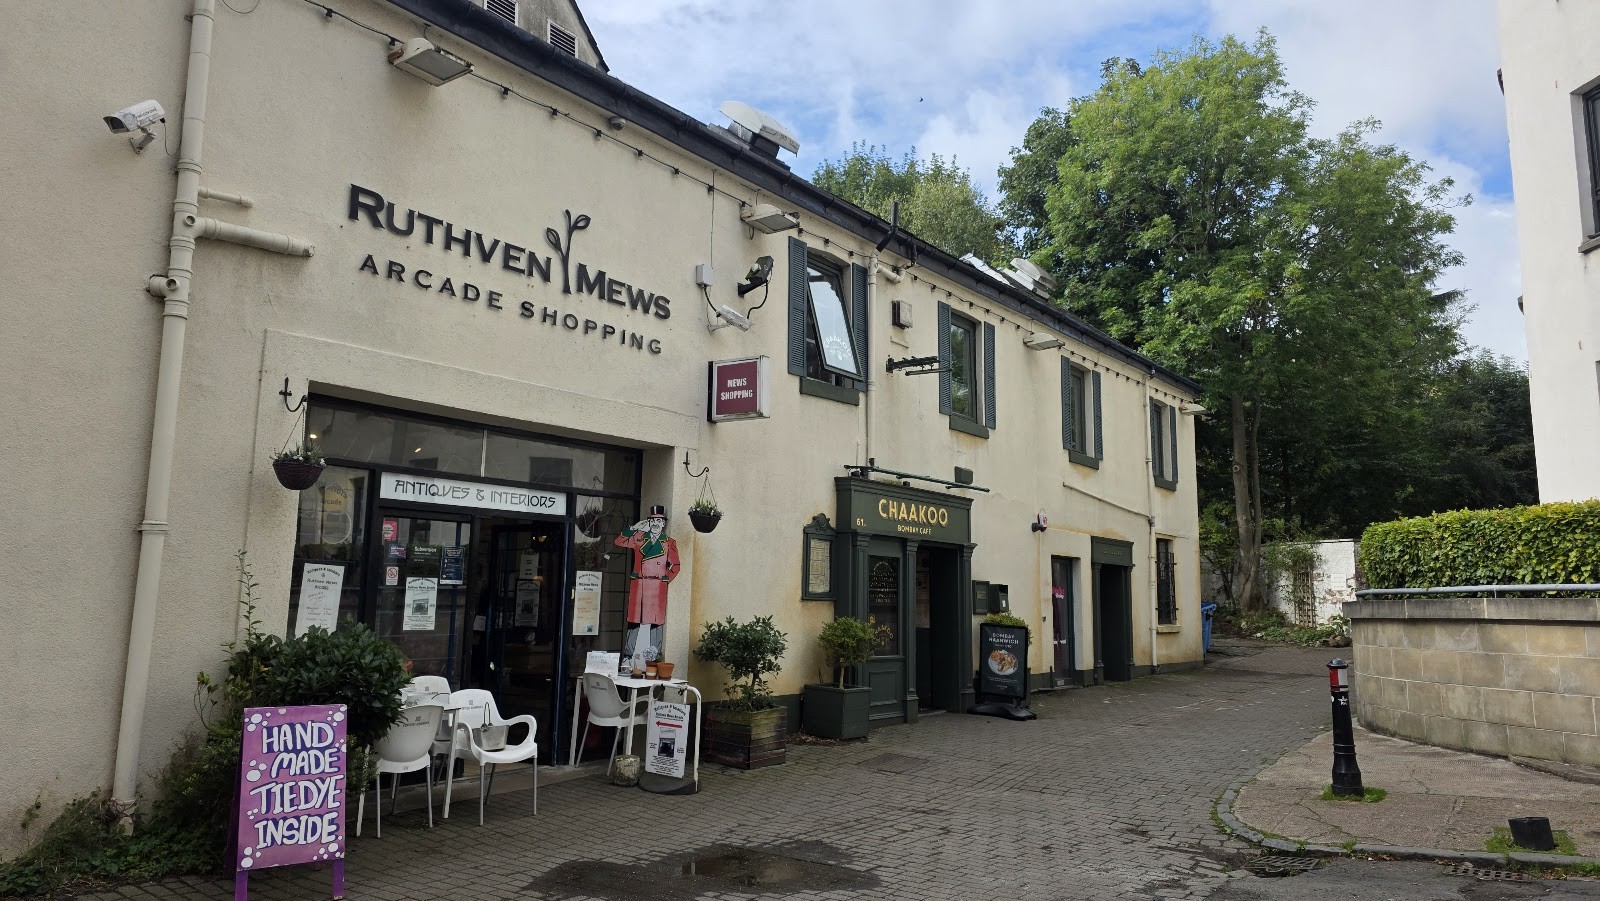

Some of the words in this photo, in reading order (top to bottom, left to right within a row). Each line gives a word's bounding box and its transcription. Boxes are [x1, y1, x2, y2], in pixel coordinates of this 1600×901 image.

[348, 183, 552, 283] RUTHVEN
[576, 262, 672, 321] MEWS
[359, 253, 504, 311] ARCADE
[519, 300, 662, 355] SHOPPING
[720, 389, 753, 401] SHOPPING
[475, 488, 485, 502] &
[490, 490, 556, 509] INTERIORS
[878, 498, 948, 527] CHAAKOO
[897, 524, 919, 534] BOMBAY
[262, 720, 334, 753] HAND
[270, 747, 339, 780] MADE
[249, 774, 345, 816] TIEDYE
[253, 811, 339, 850] INSIDE
